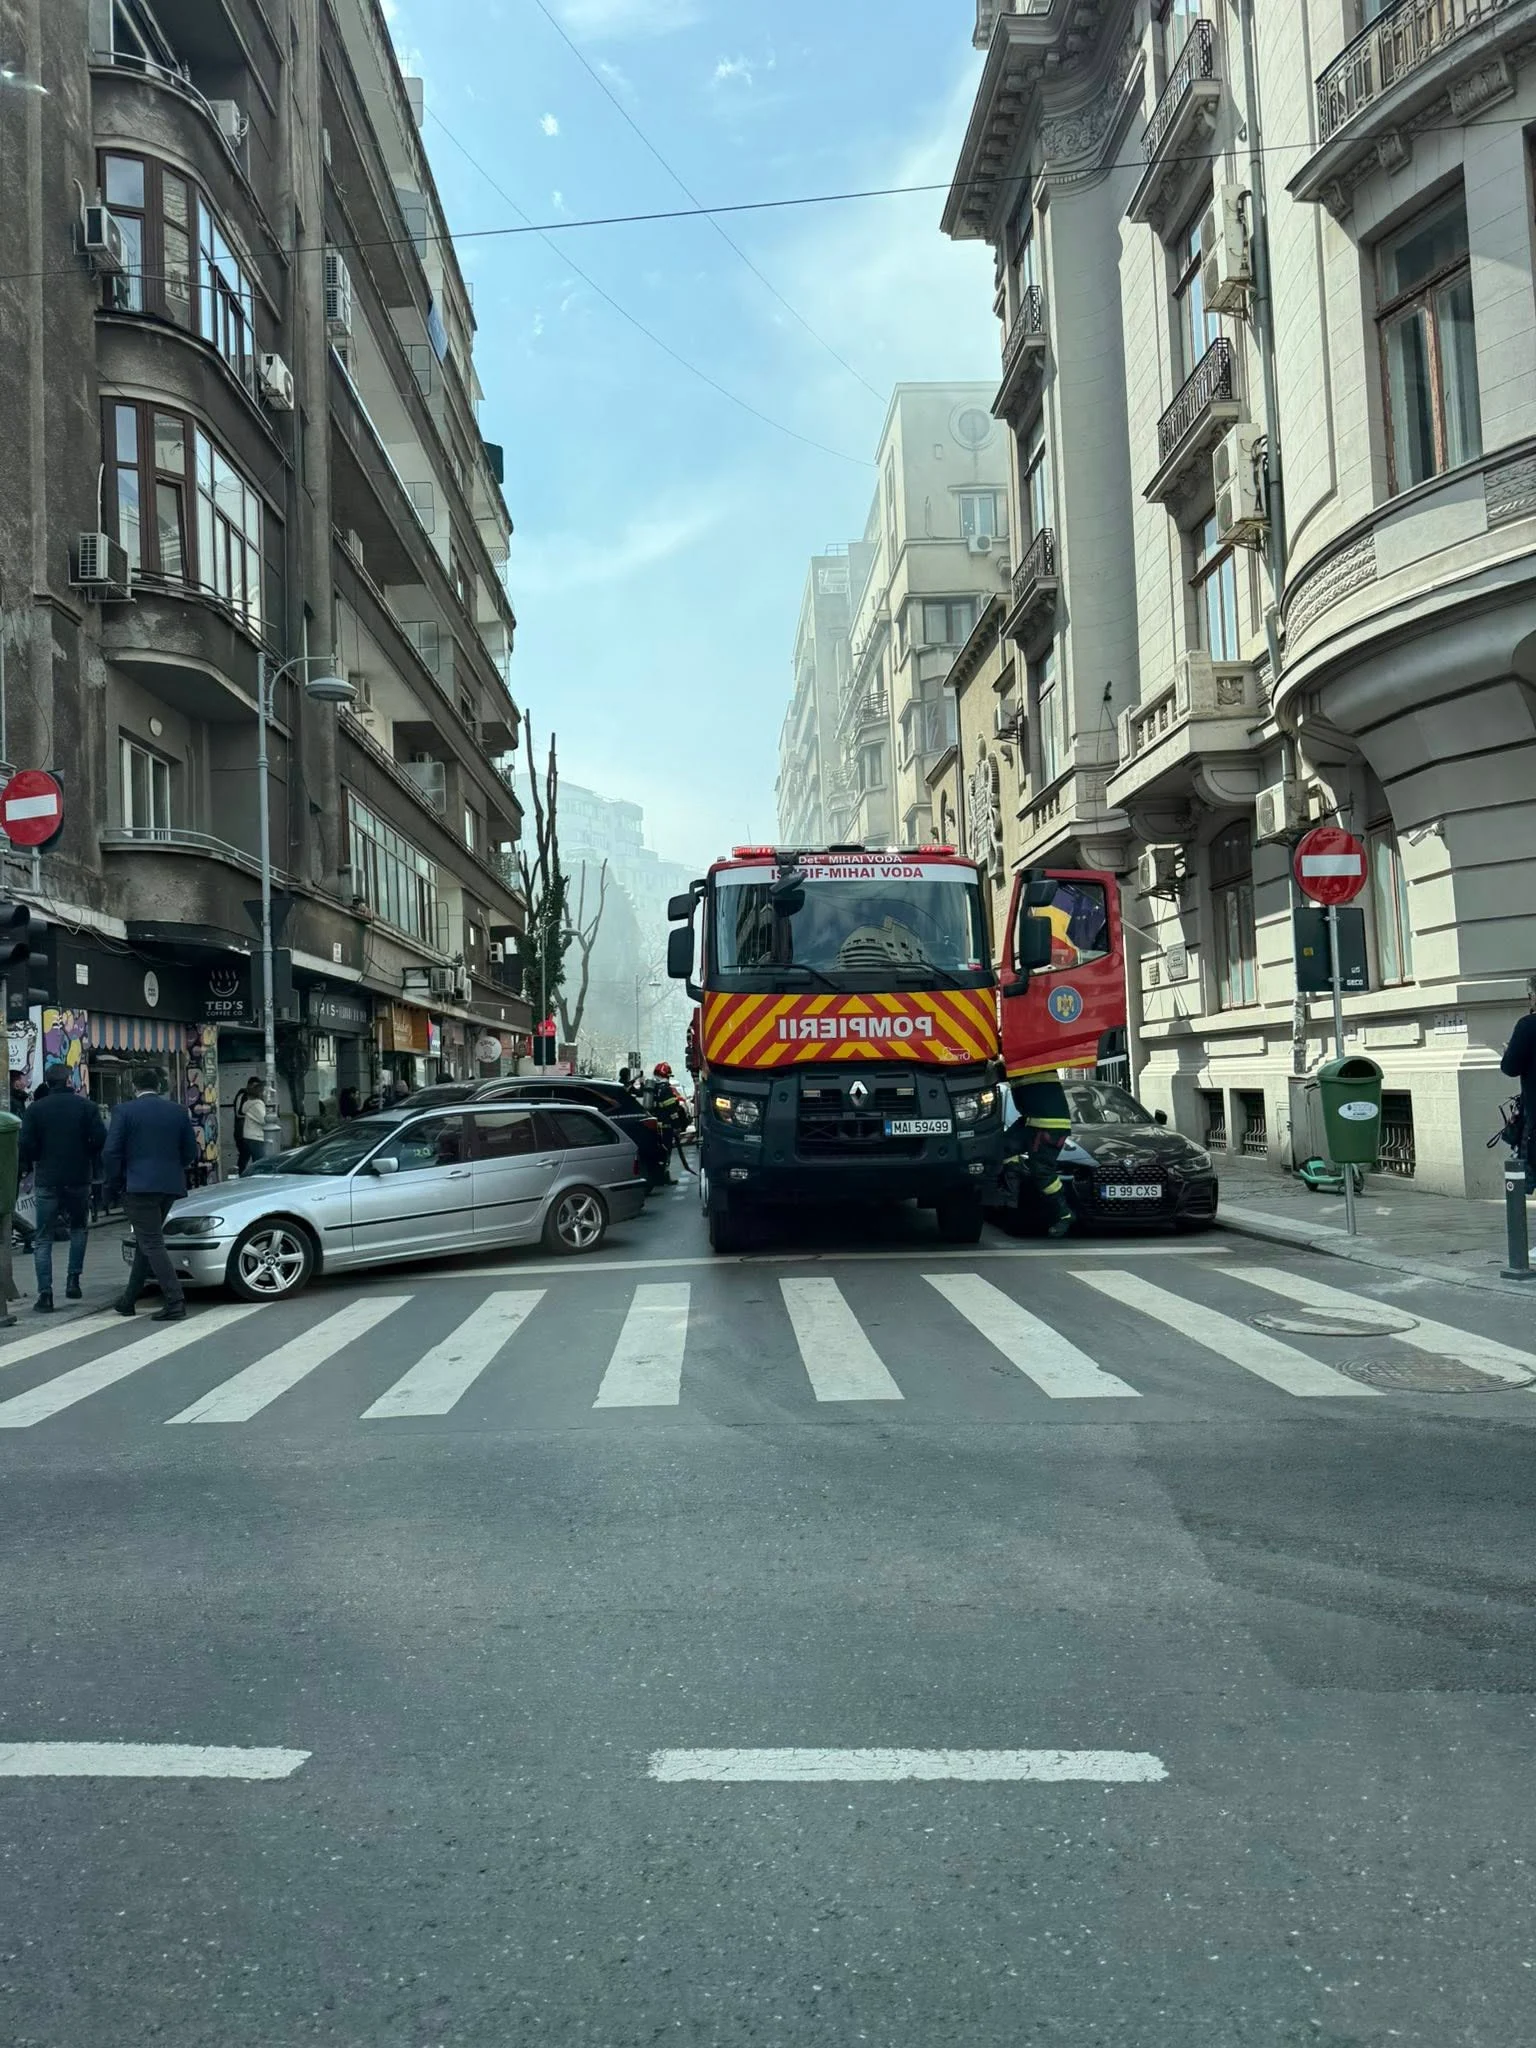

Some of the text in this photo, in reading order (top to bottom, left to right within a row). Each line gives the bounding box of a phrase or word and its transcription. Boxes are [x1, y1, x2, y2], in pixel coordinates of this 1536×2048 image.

[829, 855, 864, 864] MIHAI
[880, 867, 924, 878] VODA
[205, 1000, 243, 1010] TED'S
[894, 1122, 911, 1133] MAI
[915, 1121, 949, 1132] 59499
[1108, 1186, 1116, 1197] B
[1120, 1186, 1133, 1196] 99
[1136, 1186, 1158, 1196] CXS
